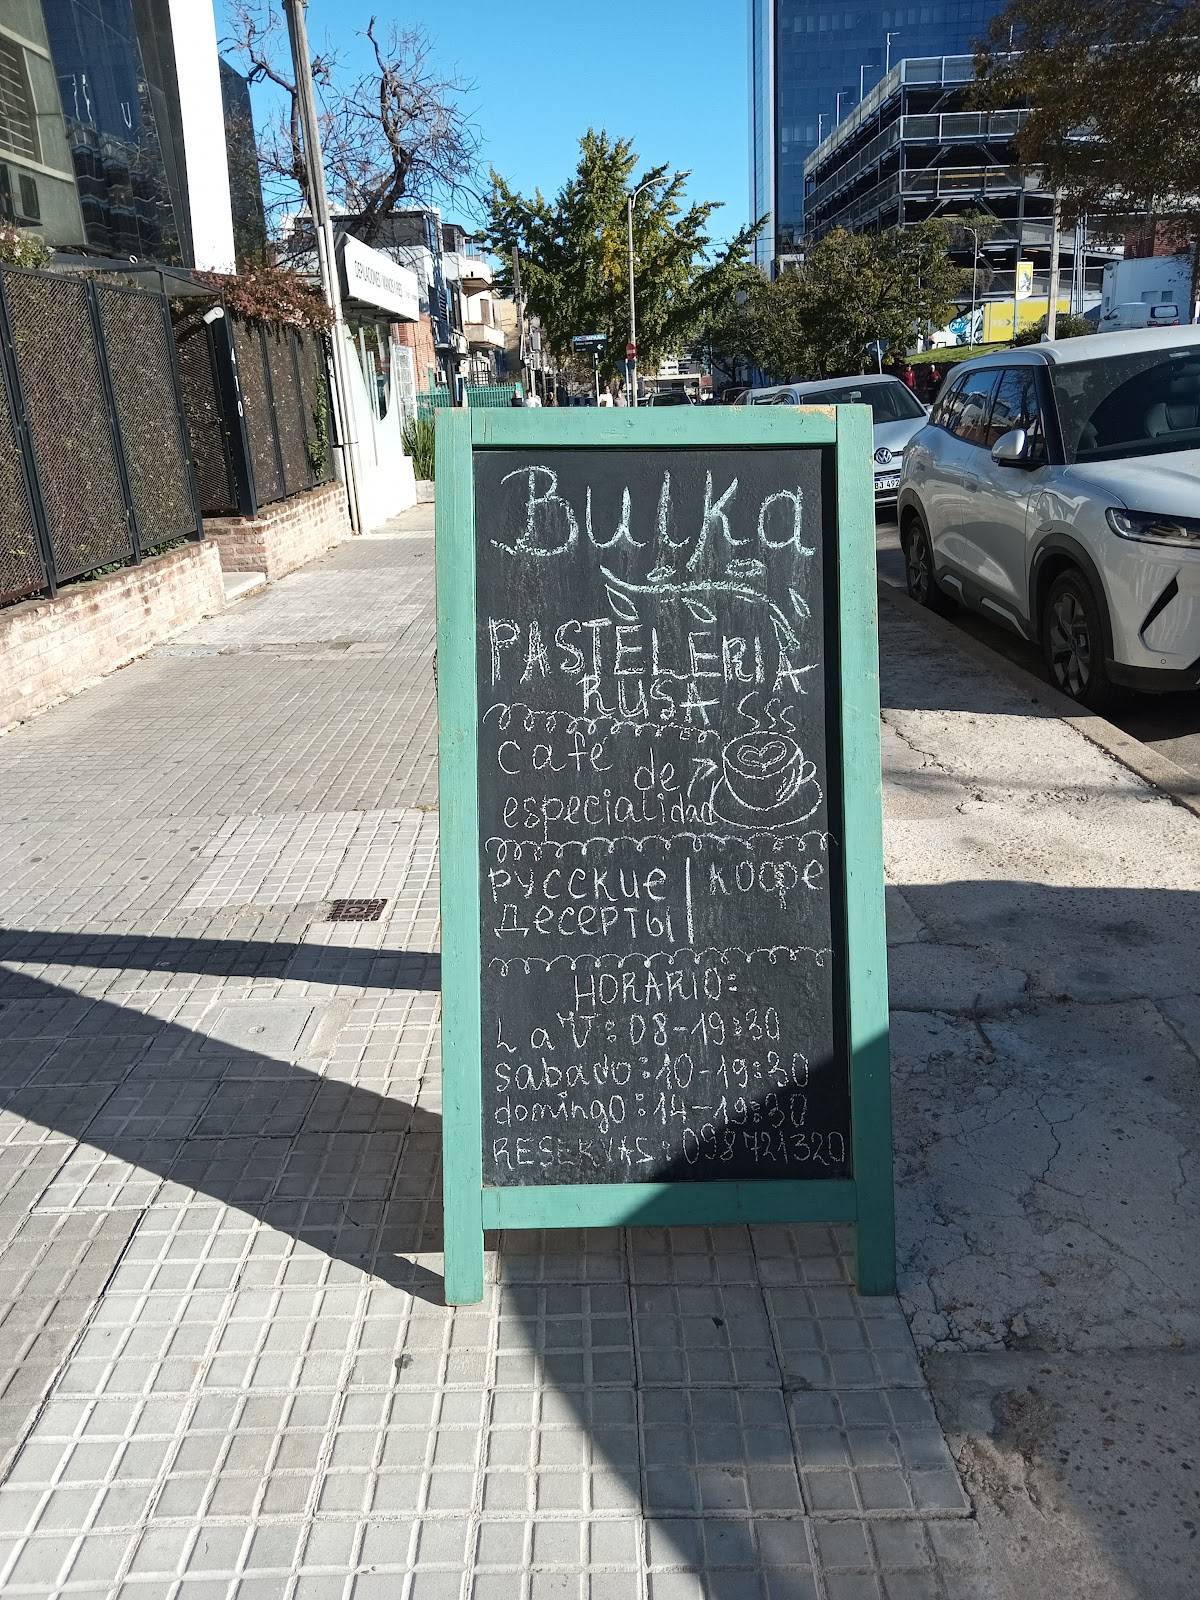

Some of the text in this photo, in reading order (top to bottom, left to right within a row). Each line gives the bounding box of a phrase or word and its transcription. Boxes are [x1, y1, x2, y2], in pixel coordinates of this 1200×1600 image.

[488, 617, 820, 694] PASTELERIA
[576, 673, 720, 725] RUSA
[633, 747, 681, 791] de
[503, 788, 717, 841] especialidad
[574, 967, 737, 1011] HORARIO:
[531, 1027, 556, 1050] a
